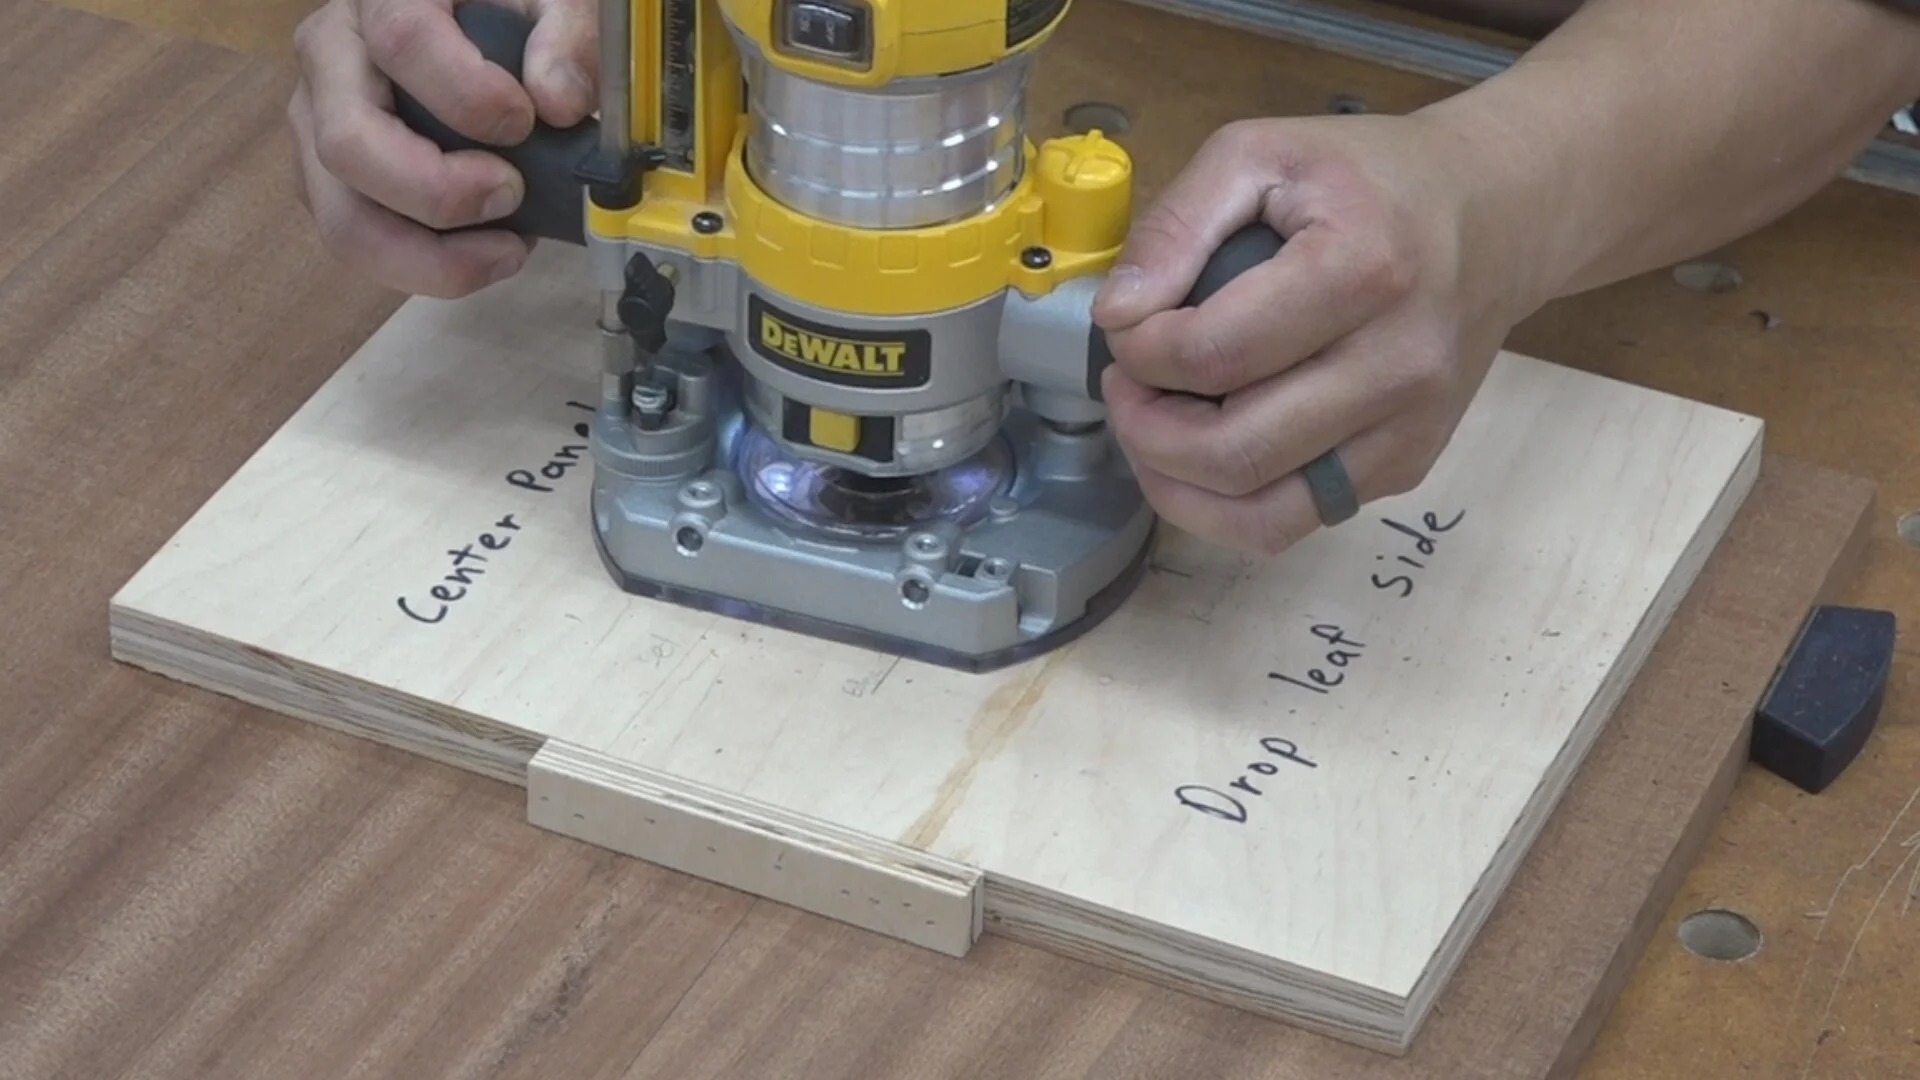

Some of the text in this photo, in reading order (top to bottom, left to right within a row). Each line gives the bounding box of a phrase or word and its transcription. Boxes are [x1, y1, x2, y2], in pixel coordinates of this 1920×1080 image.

[396, 513, 522, 624] Center
[1174, 737, 1318, 824] Drop
[1267, 623, 1367, 694] leaf
